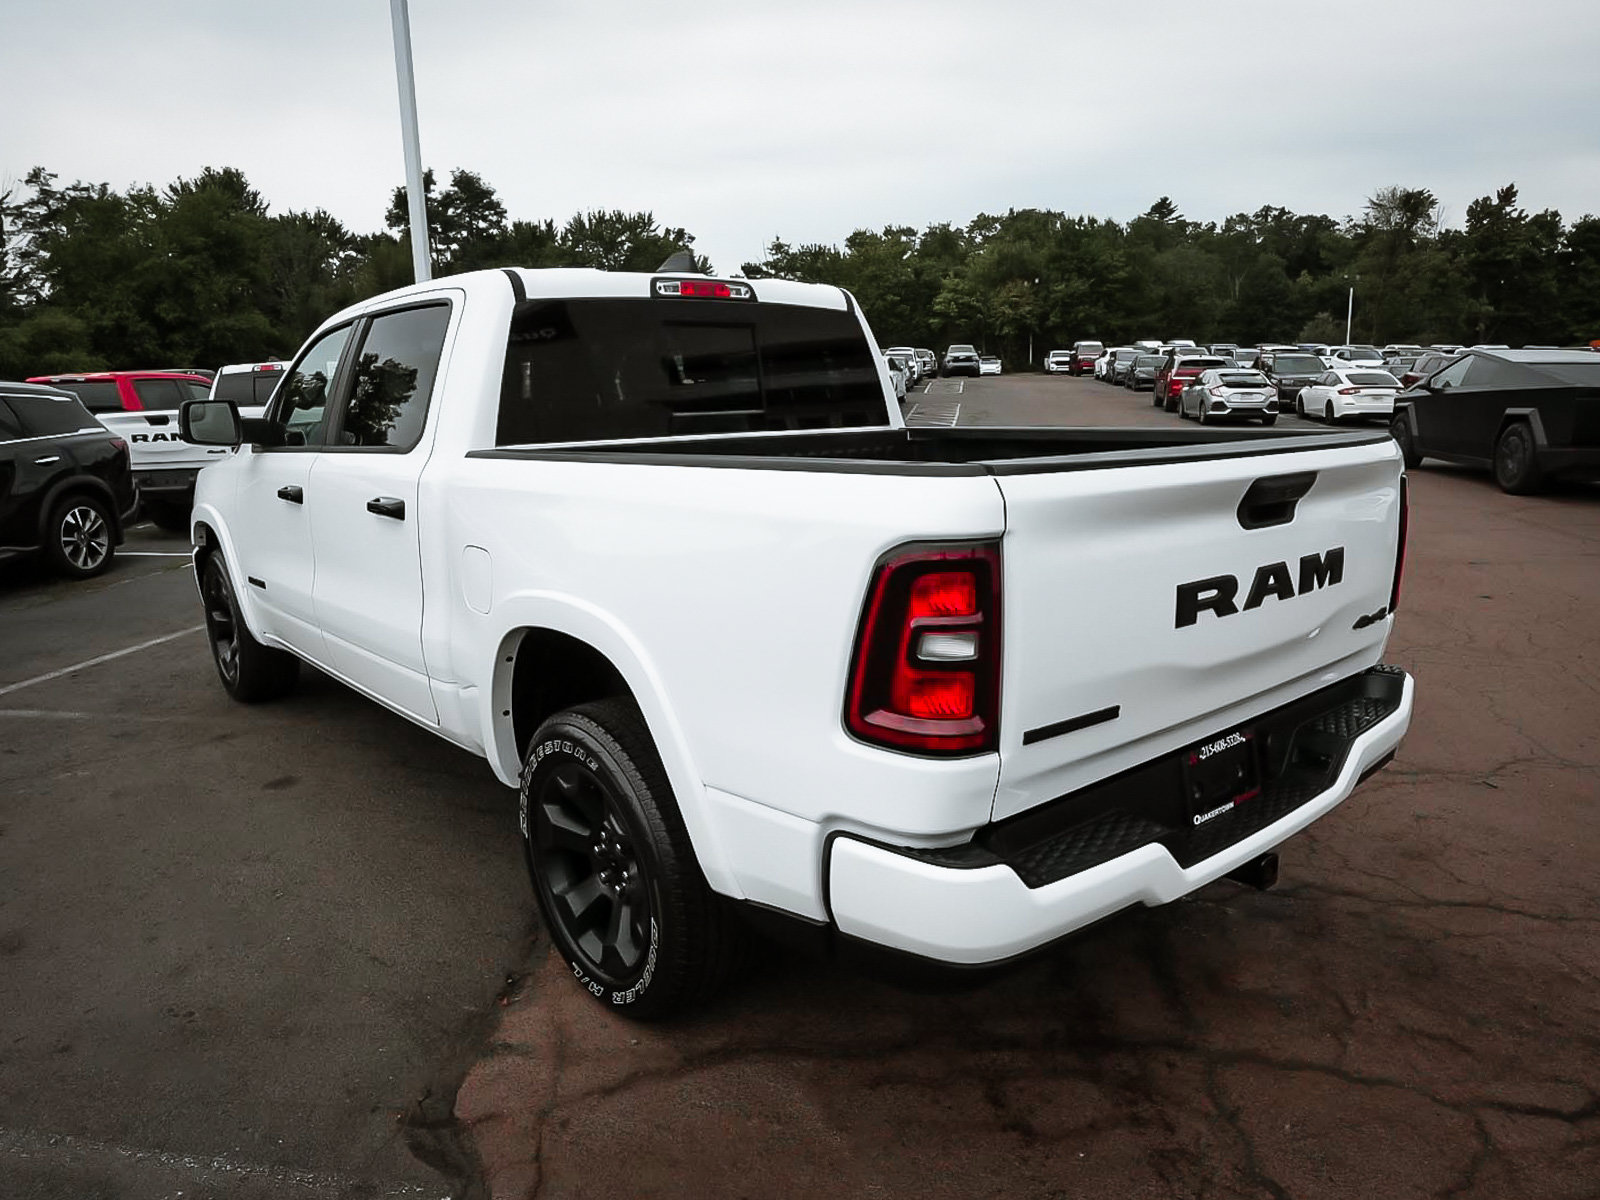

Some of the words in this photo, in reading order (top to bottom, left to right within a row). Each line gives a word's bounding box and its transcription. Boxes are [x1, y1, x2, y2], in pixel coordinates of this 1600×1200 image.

[1175, 546, 1344, 629] RAM
[571, 961, 605, 996] H/L
[612, 917, 659, 1004] DUELER
